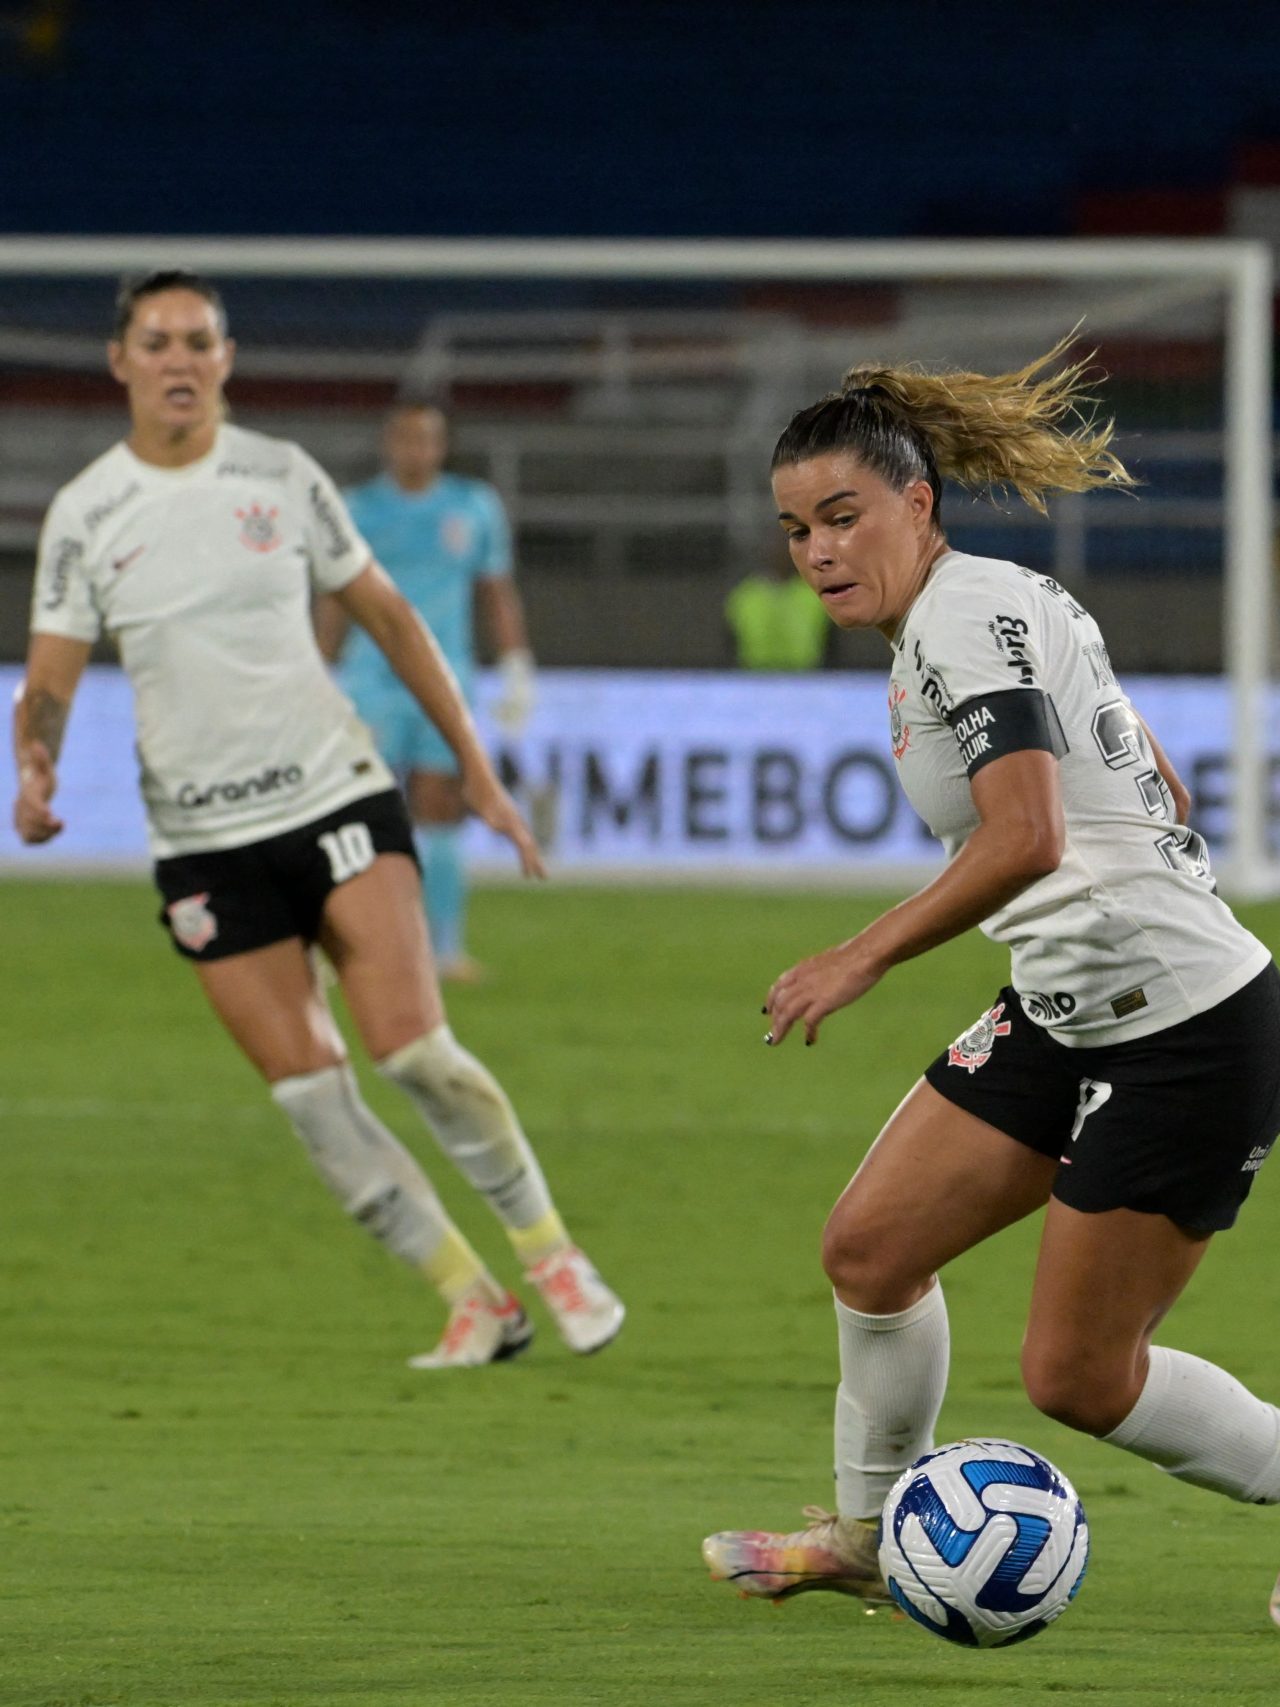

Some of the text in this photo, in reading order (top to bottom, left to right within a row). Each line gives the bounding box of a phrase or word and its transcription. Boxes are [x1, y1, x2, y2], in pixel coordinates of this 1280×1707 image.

[962, 731, 993, 766] LUIR
[178, 765, 303, 809] Granito
[496, 746, 934, 848] NMEBO
[317, 822, 376, 884] 10
